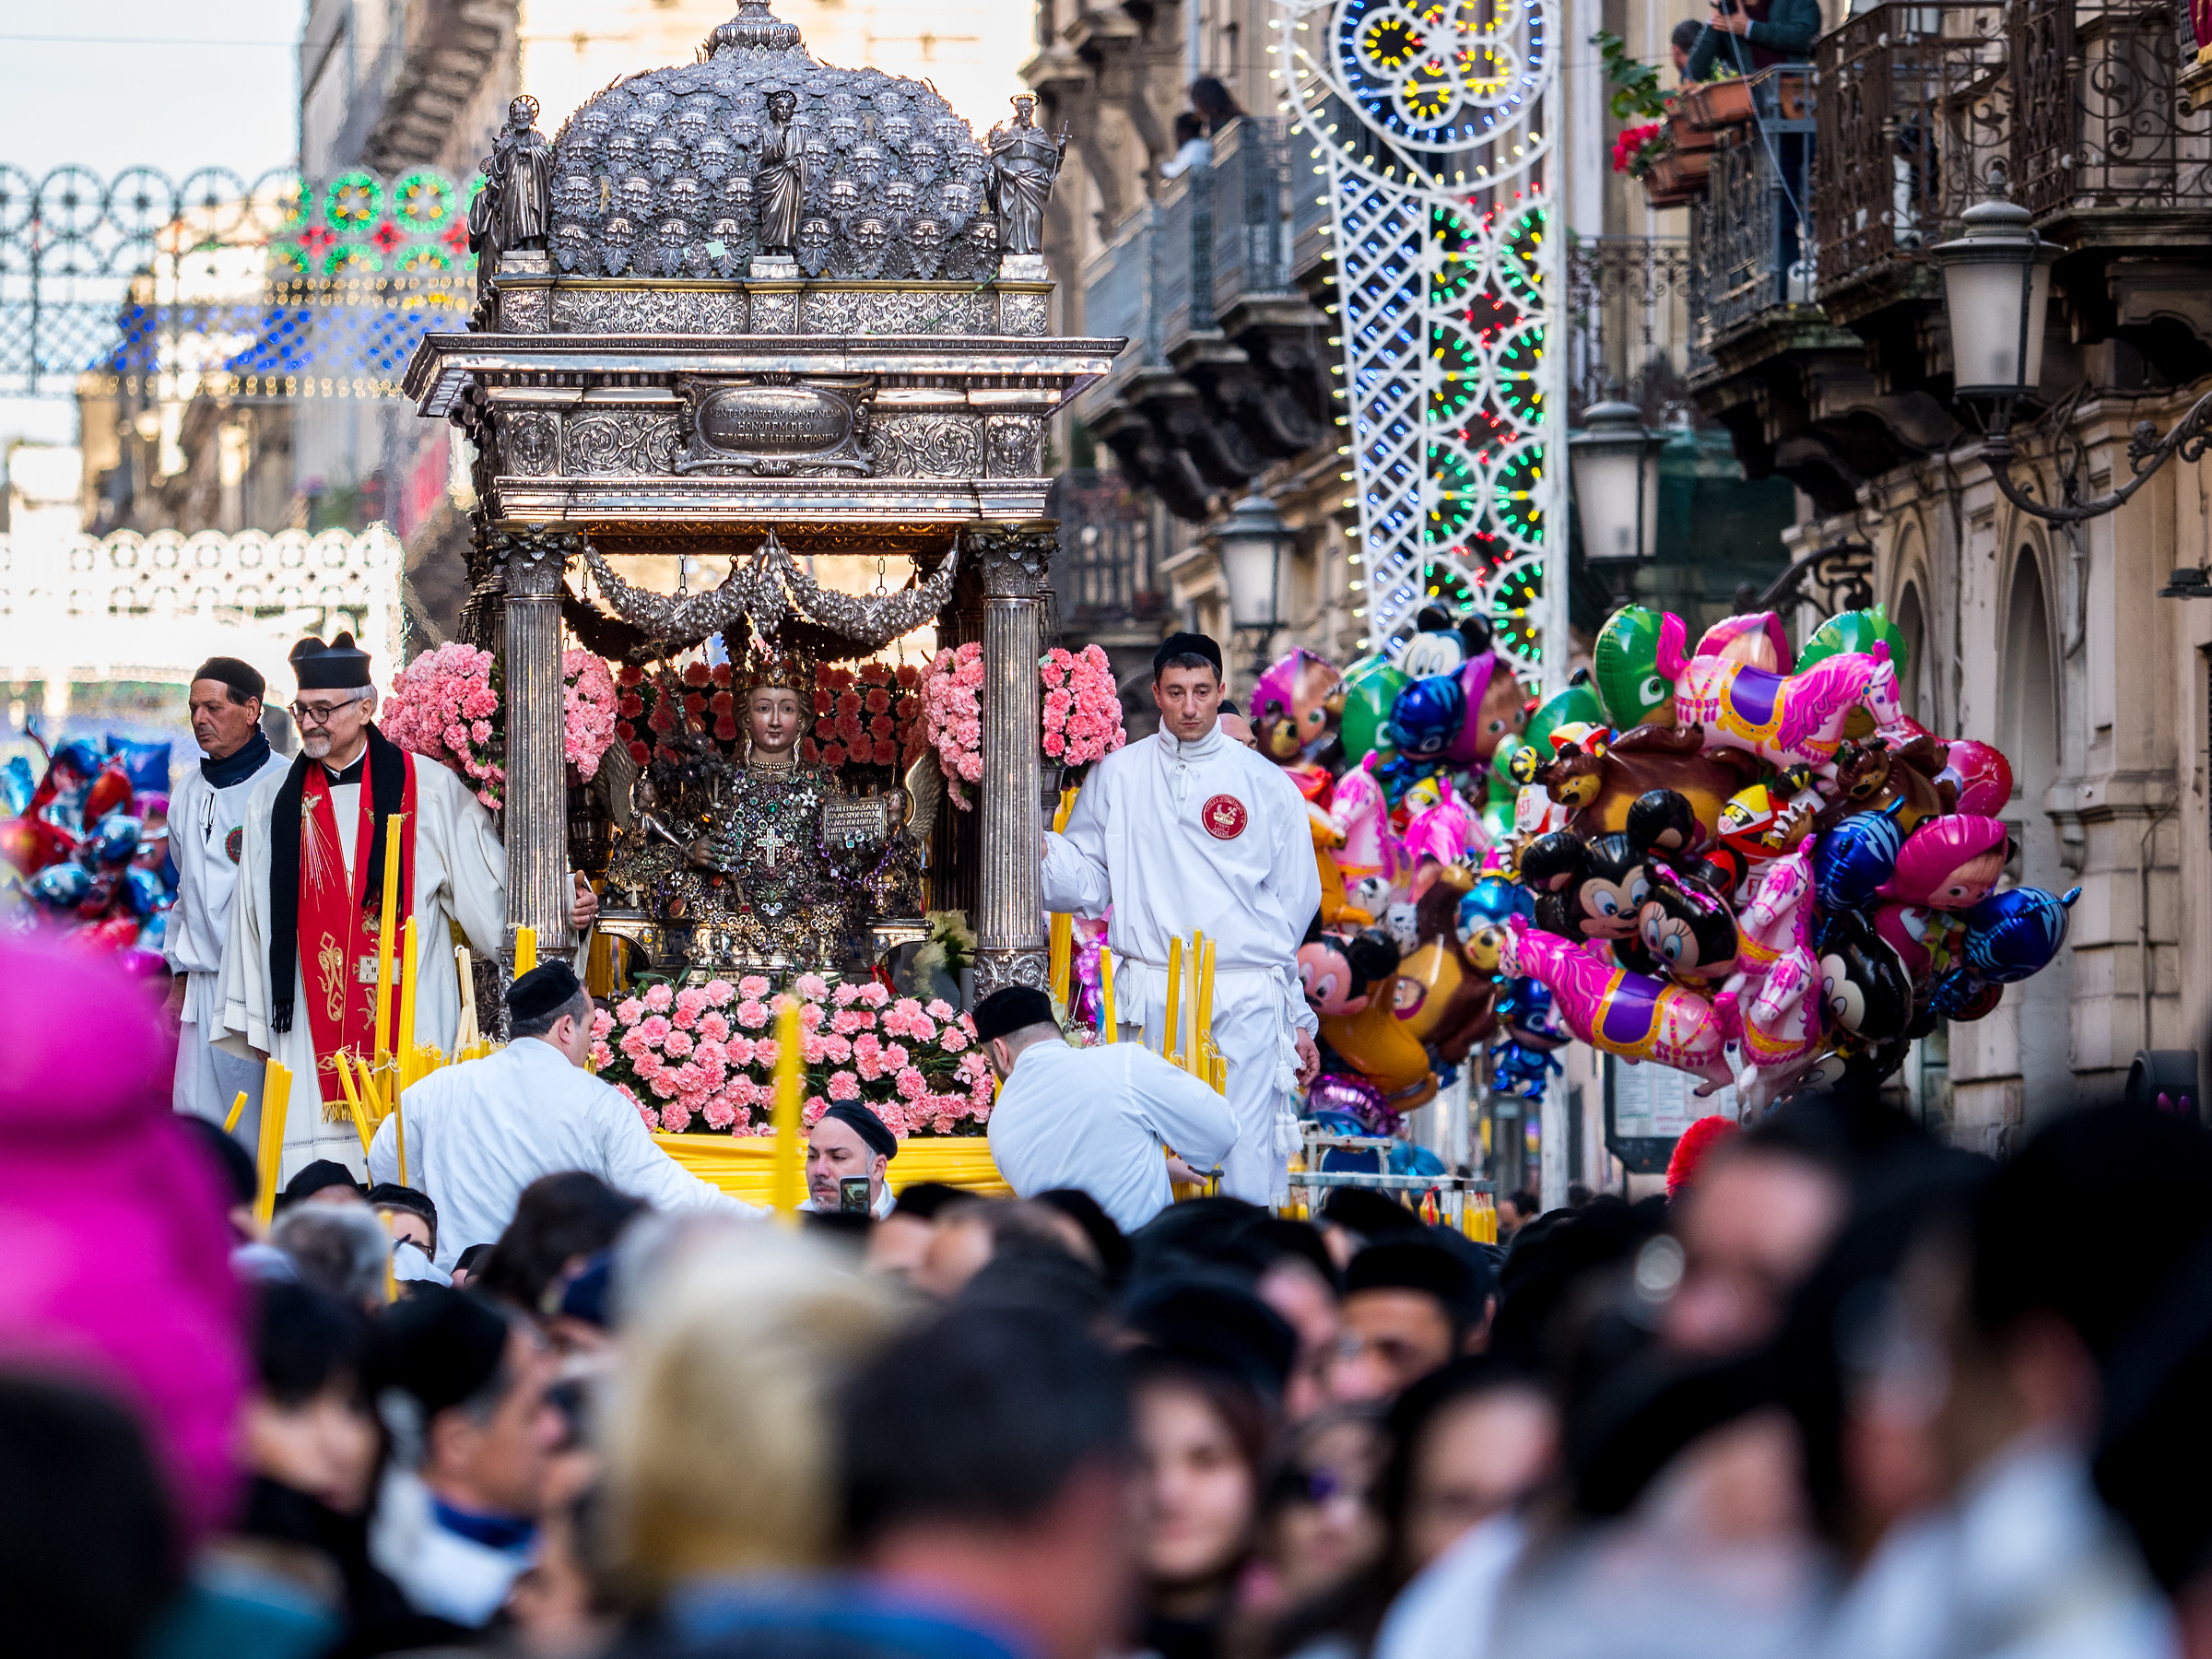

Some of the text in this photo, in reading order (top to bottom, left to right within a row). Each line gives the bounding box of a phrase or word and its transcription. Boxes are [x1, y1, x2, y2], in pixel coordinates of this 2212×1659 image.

[747, 408, 785, 419] SANCTAM
[737, 420, 812, 431] HONOREM DEO
[712, 431, 840, 443] ET PATRIAE LIBERATIONEM
